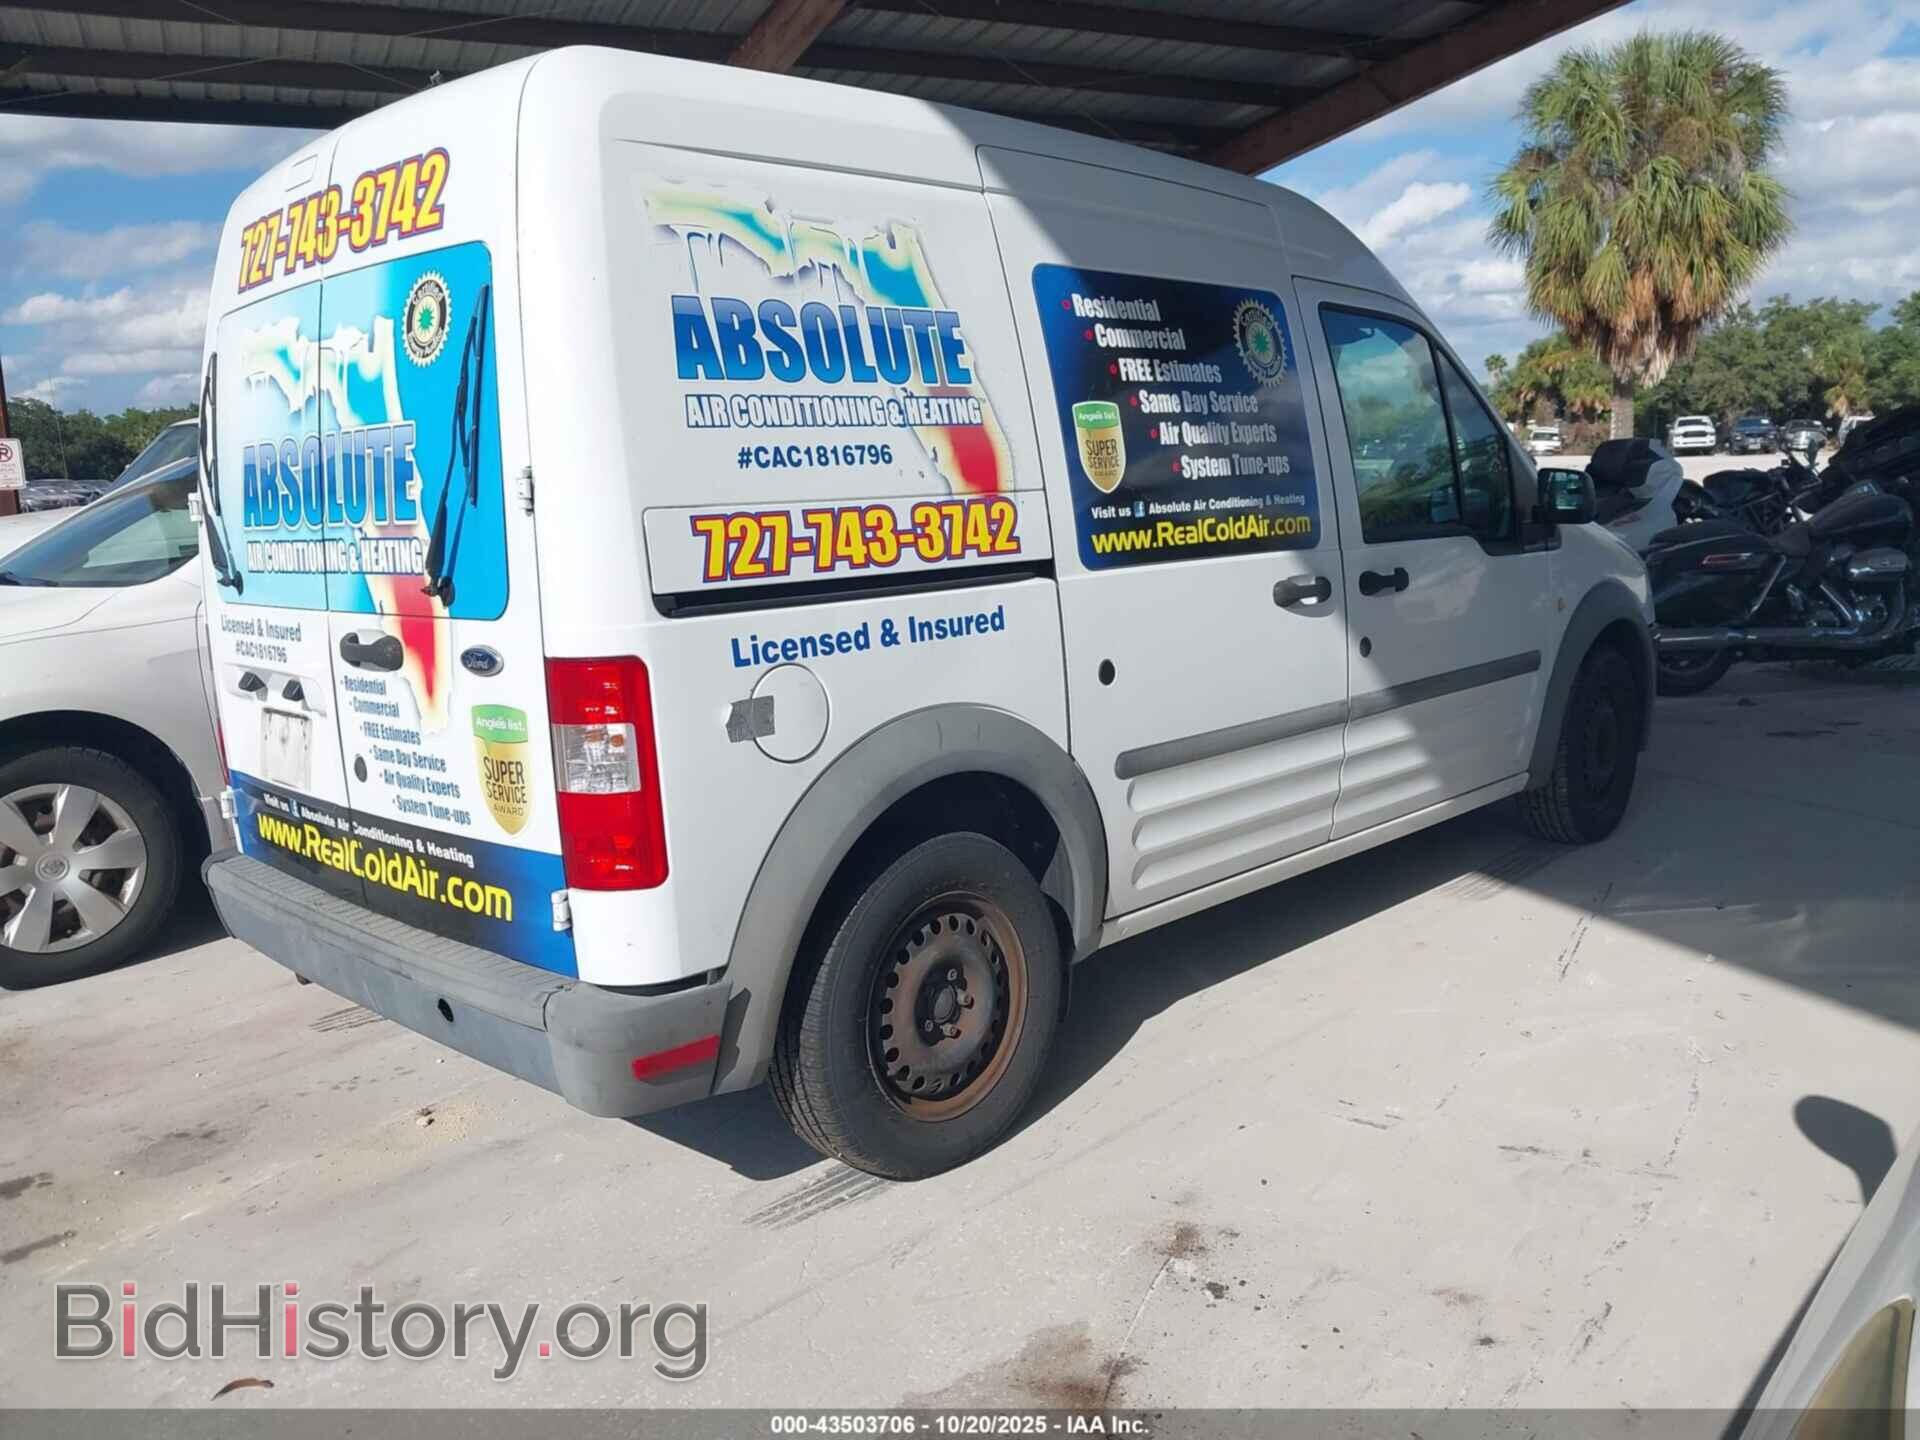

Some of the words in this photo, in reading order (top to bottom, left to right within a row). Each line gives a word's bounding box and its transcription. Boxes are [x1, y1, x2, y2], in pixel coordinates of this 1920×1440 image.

[238, 147, 450, 294] 727-743-3742
[1071, 293, 1161, 322] Residential
[669, 294, 974, 387] ABSOLUTE
[1094, 323, 1186, 351] Commercial
[1118, 358, 1154, 382] FREE
[1156, 359, 1222, 384] Estimates
[685, 394, 730, 428] AIR
[730, 394, 888, 428] CONDITIONING
[887, 397, 906, 427] &
[906, 394, 983, 427] HEATING
[1138, 389, 1181, 414] Same
[1182, 391, 1208, 415] Day
[1209, 391, 1259, 414] Service
[1085, 438, 1118, 456] SUPER
[1159, 422, 1180, 445] Air
[1181, 422, 1229, 446] Quality
[1231, 422, 1277, 445] Experts
[738, 444, 893, 469] #CAC1816796
[1087, 455, 1120, 470] SERVICE
[1181, 455, 1232, 480] System
[1233, 454, 1290, 477] Tune-ups
[243, 421, 418, 531] ABSOLUTE
[1091, 505, 1116, 519] Visit
[1118, 507, 1131, 518] us
[1148, 500, 1191, 515] Absolute
[1193, 499, 1206, 511] Air
[1208, 495, 1263, 511] Conditioning
[1273, 494, 1305, 506] Heating
[690, 496, 1021, 583] 727-743-3742
[1091, 514, 1311, 554] www.RealColdAir.com
[247, 540, 264, 574] AIR
[264, 538, 348, 575] CONDITIONING
[360, 536, 424, 576] HEATING
[221, 613, 255, 637] Licensed
[265, 618, 302, 643] Insured
[731, 622, 870, 668] Licensed
[880, 619, 900, 648] &
[908, 605, 1005, 643] Insured
[343, 675, 387, 696] Residential
[353, 696, 400, 718] Commercial
[363, 721, 380, 740] FREE
[381, 724, 422, 746] Estimates
[373, 744, 395, 764] Same
[396, 748, 412, 768] Day
[412, 751, 447, 773] Service
[483, 756, 525, 785] SUPER
[384, 769, 395, 785] Air
[396, 771, 426, 794] Quality
[426, 777, 461, 799] Experts
[485, 781, 528, 805] SERVICE
[396, 795, 427, 817] System
[428, 801, 471, 826] Tune-ups
[494, 803, 524, 817] AWARD
[264, 793, 280, 808] Visit
[301, 806, 336, 828] Absolute
[337, 815, 350, 832] Air
[352, 820, 414, 853] Conditioning
[416, 838, 423, 851] &
[427, 841, 475, 869] Heating
[257, 813, 512, 922] www.RealColdAir.com
